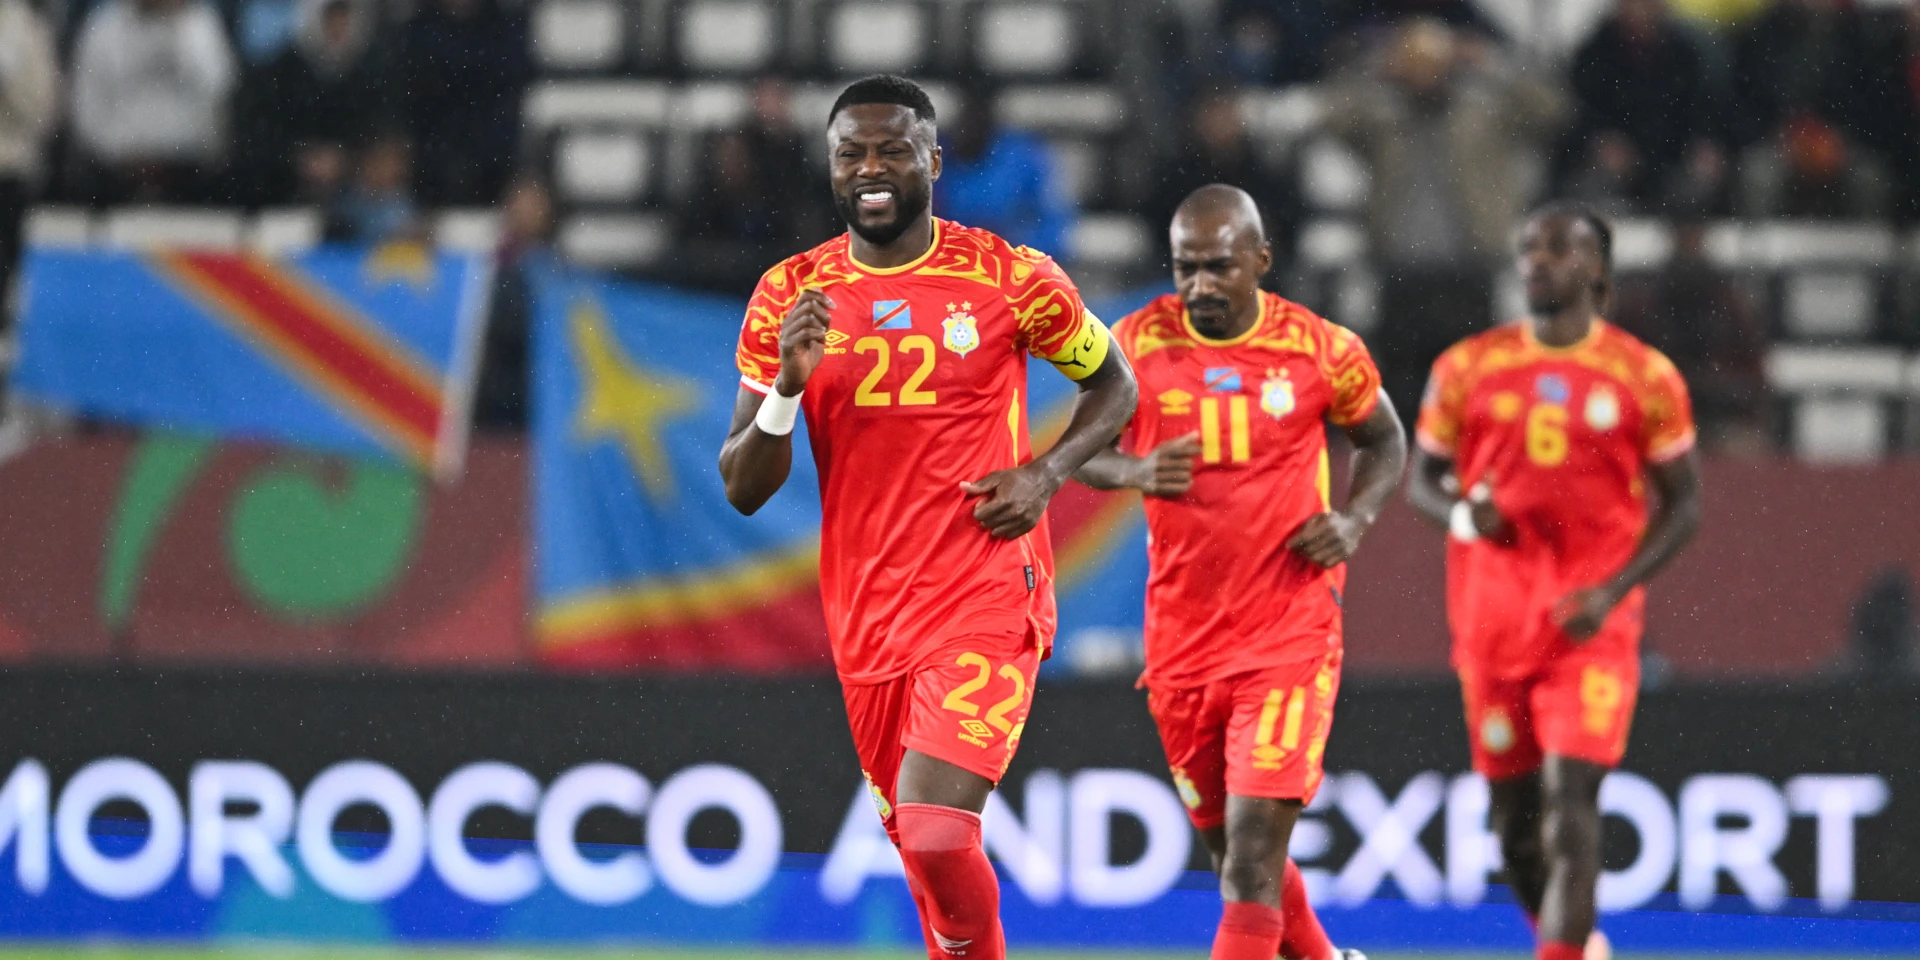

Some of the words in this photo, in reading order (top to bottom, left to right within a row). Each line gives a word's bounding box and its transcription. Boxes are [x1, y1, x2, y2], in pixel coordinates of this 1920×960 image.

[823, 347, 847, 355] mbro
[853, 335, 937, 406] 22
[1201, 396, 1249, 463] 11
[1526, 402, 1568, 467] 6
[941, 651, 1025, 735] 22
[1255, 685, 1305, 750] 11
[957, 732, 988, 749] umbro
